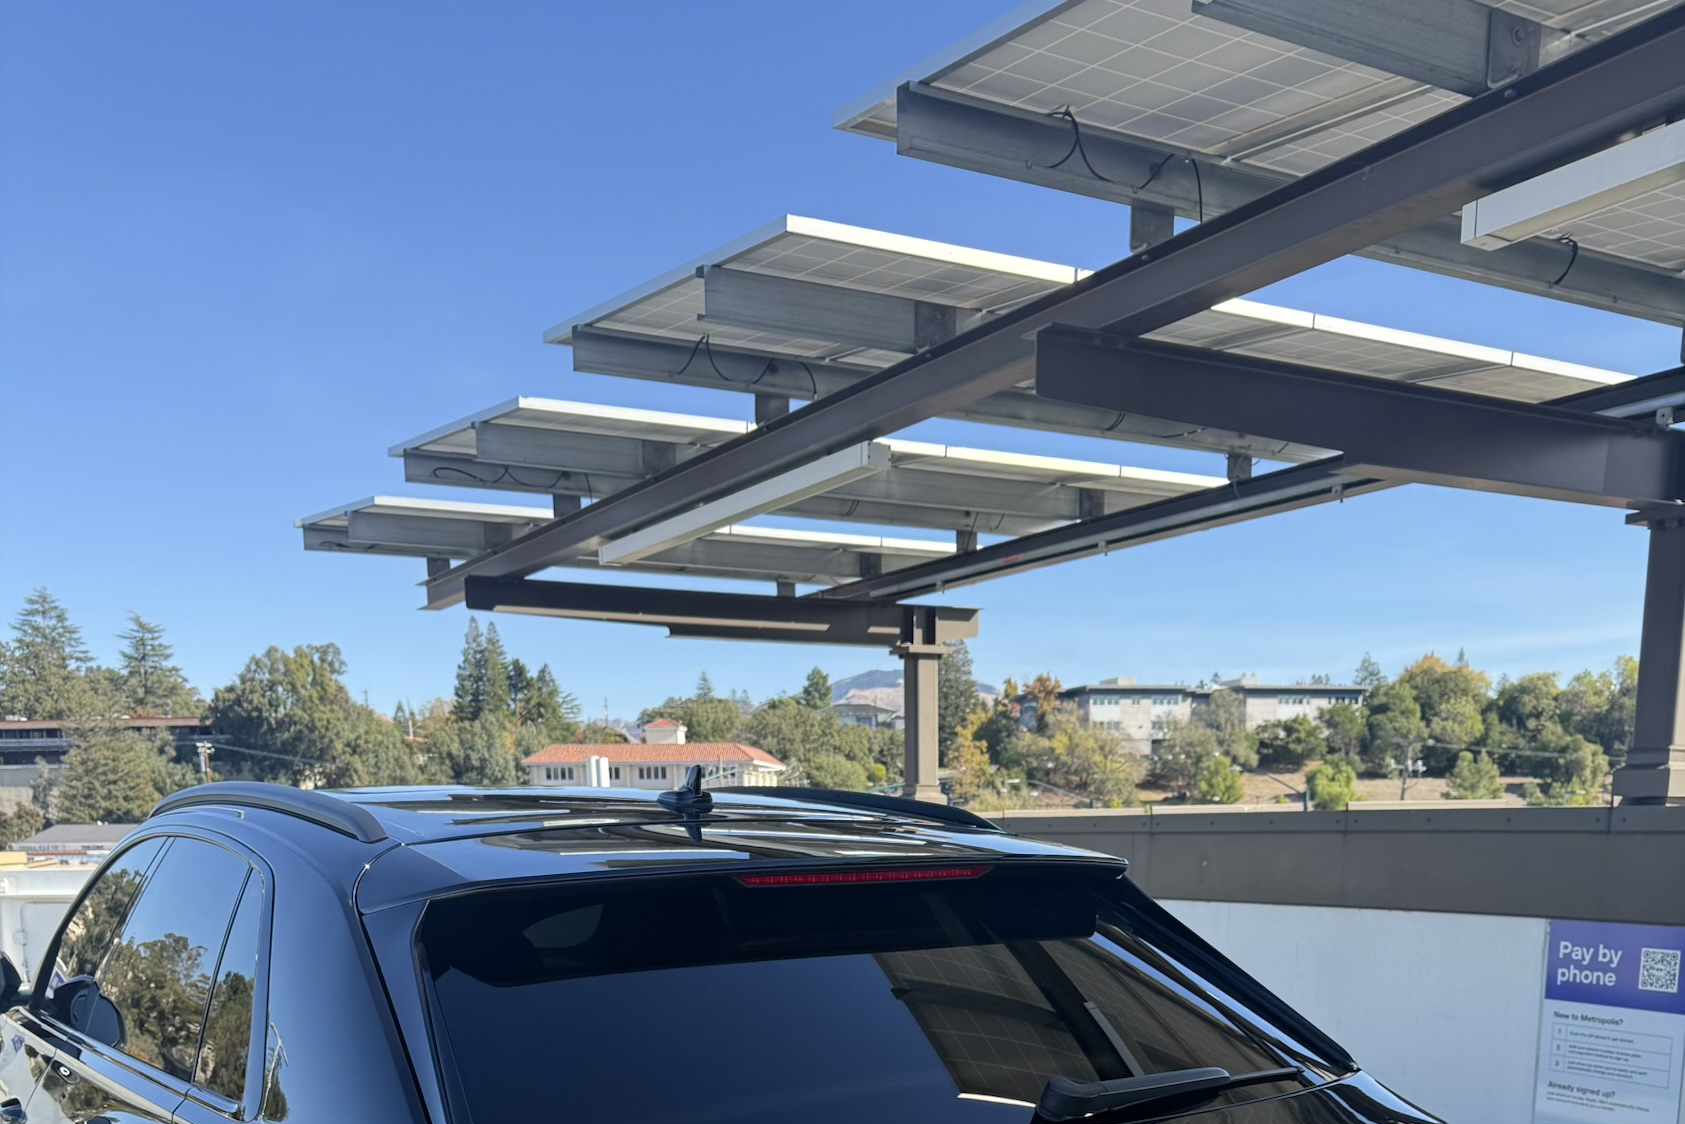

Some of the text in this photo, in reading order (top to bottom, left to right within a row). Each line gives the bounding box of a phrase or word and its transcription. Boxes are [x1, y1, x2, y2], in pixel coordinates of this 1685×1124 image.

[1559, 941, 1623, 968] Pay by
[1557, 965, 1616, 986] phone
[1554, 1011, 1624, 1026] New to Metropolis?
[1548, 1081, 1616, 1099] Already signed up?
